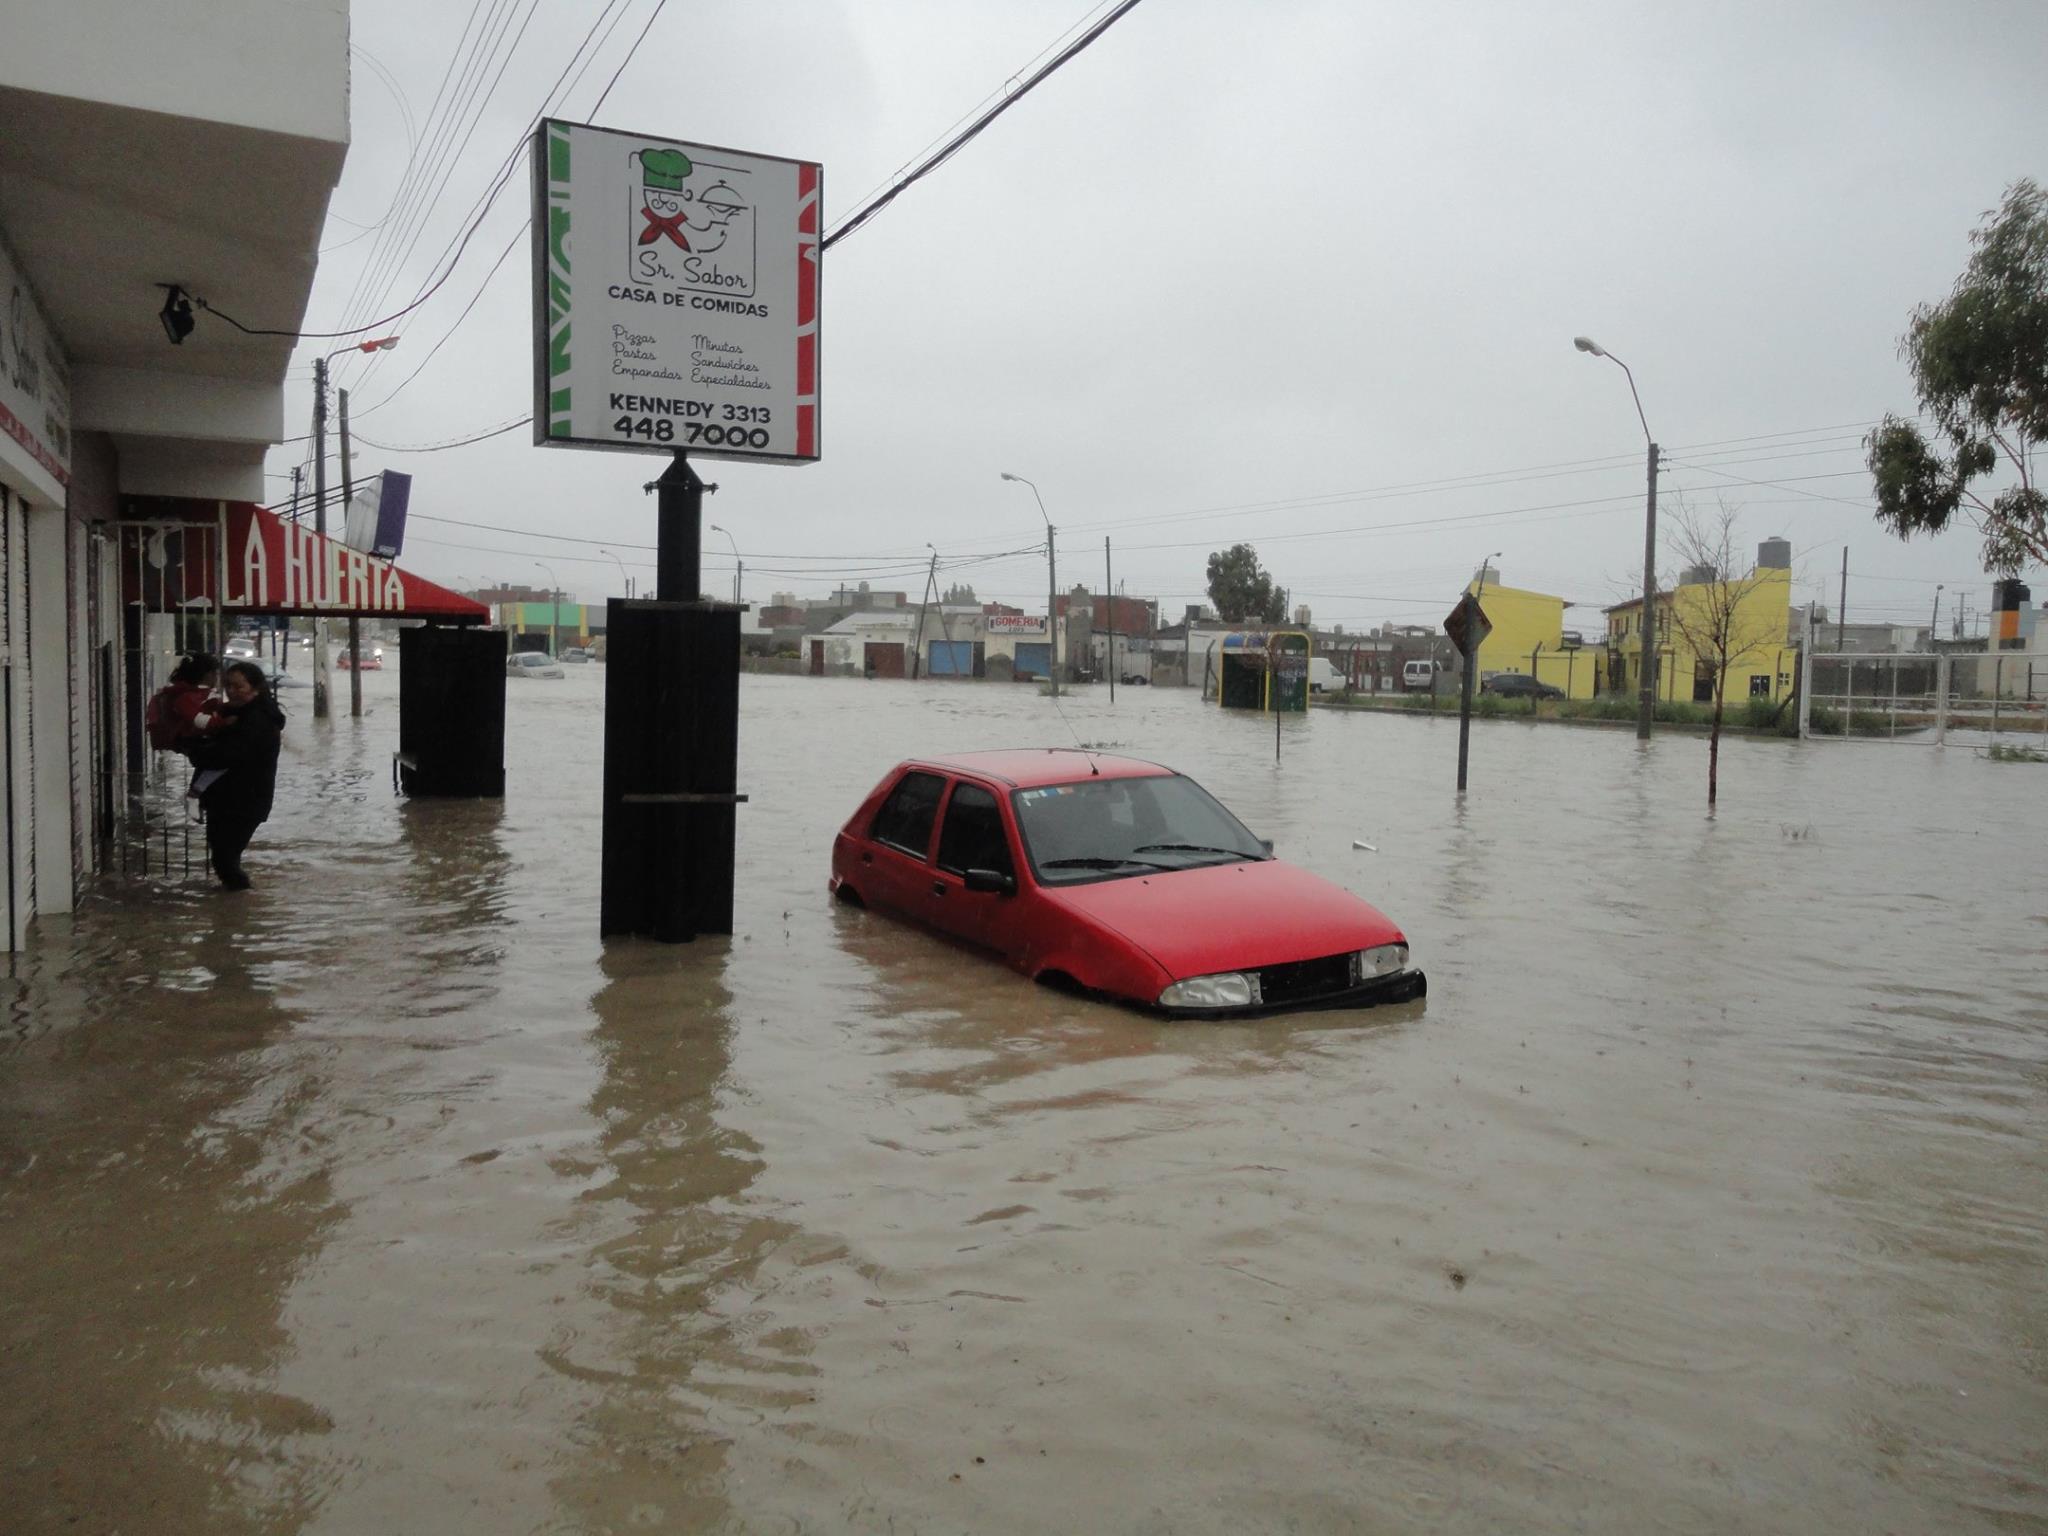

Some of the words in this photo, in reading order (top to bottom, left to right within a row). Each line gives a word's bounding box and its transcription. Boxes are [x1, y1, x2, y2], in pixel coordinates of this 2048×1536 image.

[639, 250, 674, 279] Sr.
[683, 257, 747, 289] Sabor
[608, 285, 657, 304] CASA
[663, 292, 685, 307] DE
[691, 296, 768, 317] COMIDAS
[612, 324, 656, 346] Pizzas
[691, 334, 743, 354] Minutas
[612, 341, 656, 360] Pastas
[691, 351, 759, 372] Sandwiches
[612, 359, 682, 380] Empanadas
[609, 393, 714, 419] KENNEDY
[722, 404, 771, 424] 3313
[613, 415, 674, 442] 448
[684, 422, 770, 449] 7000
[218, 502, 268, 608] LA
[278, 518, 405, 611] HUERTA
